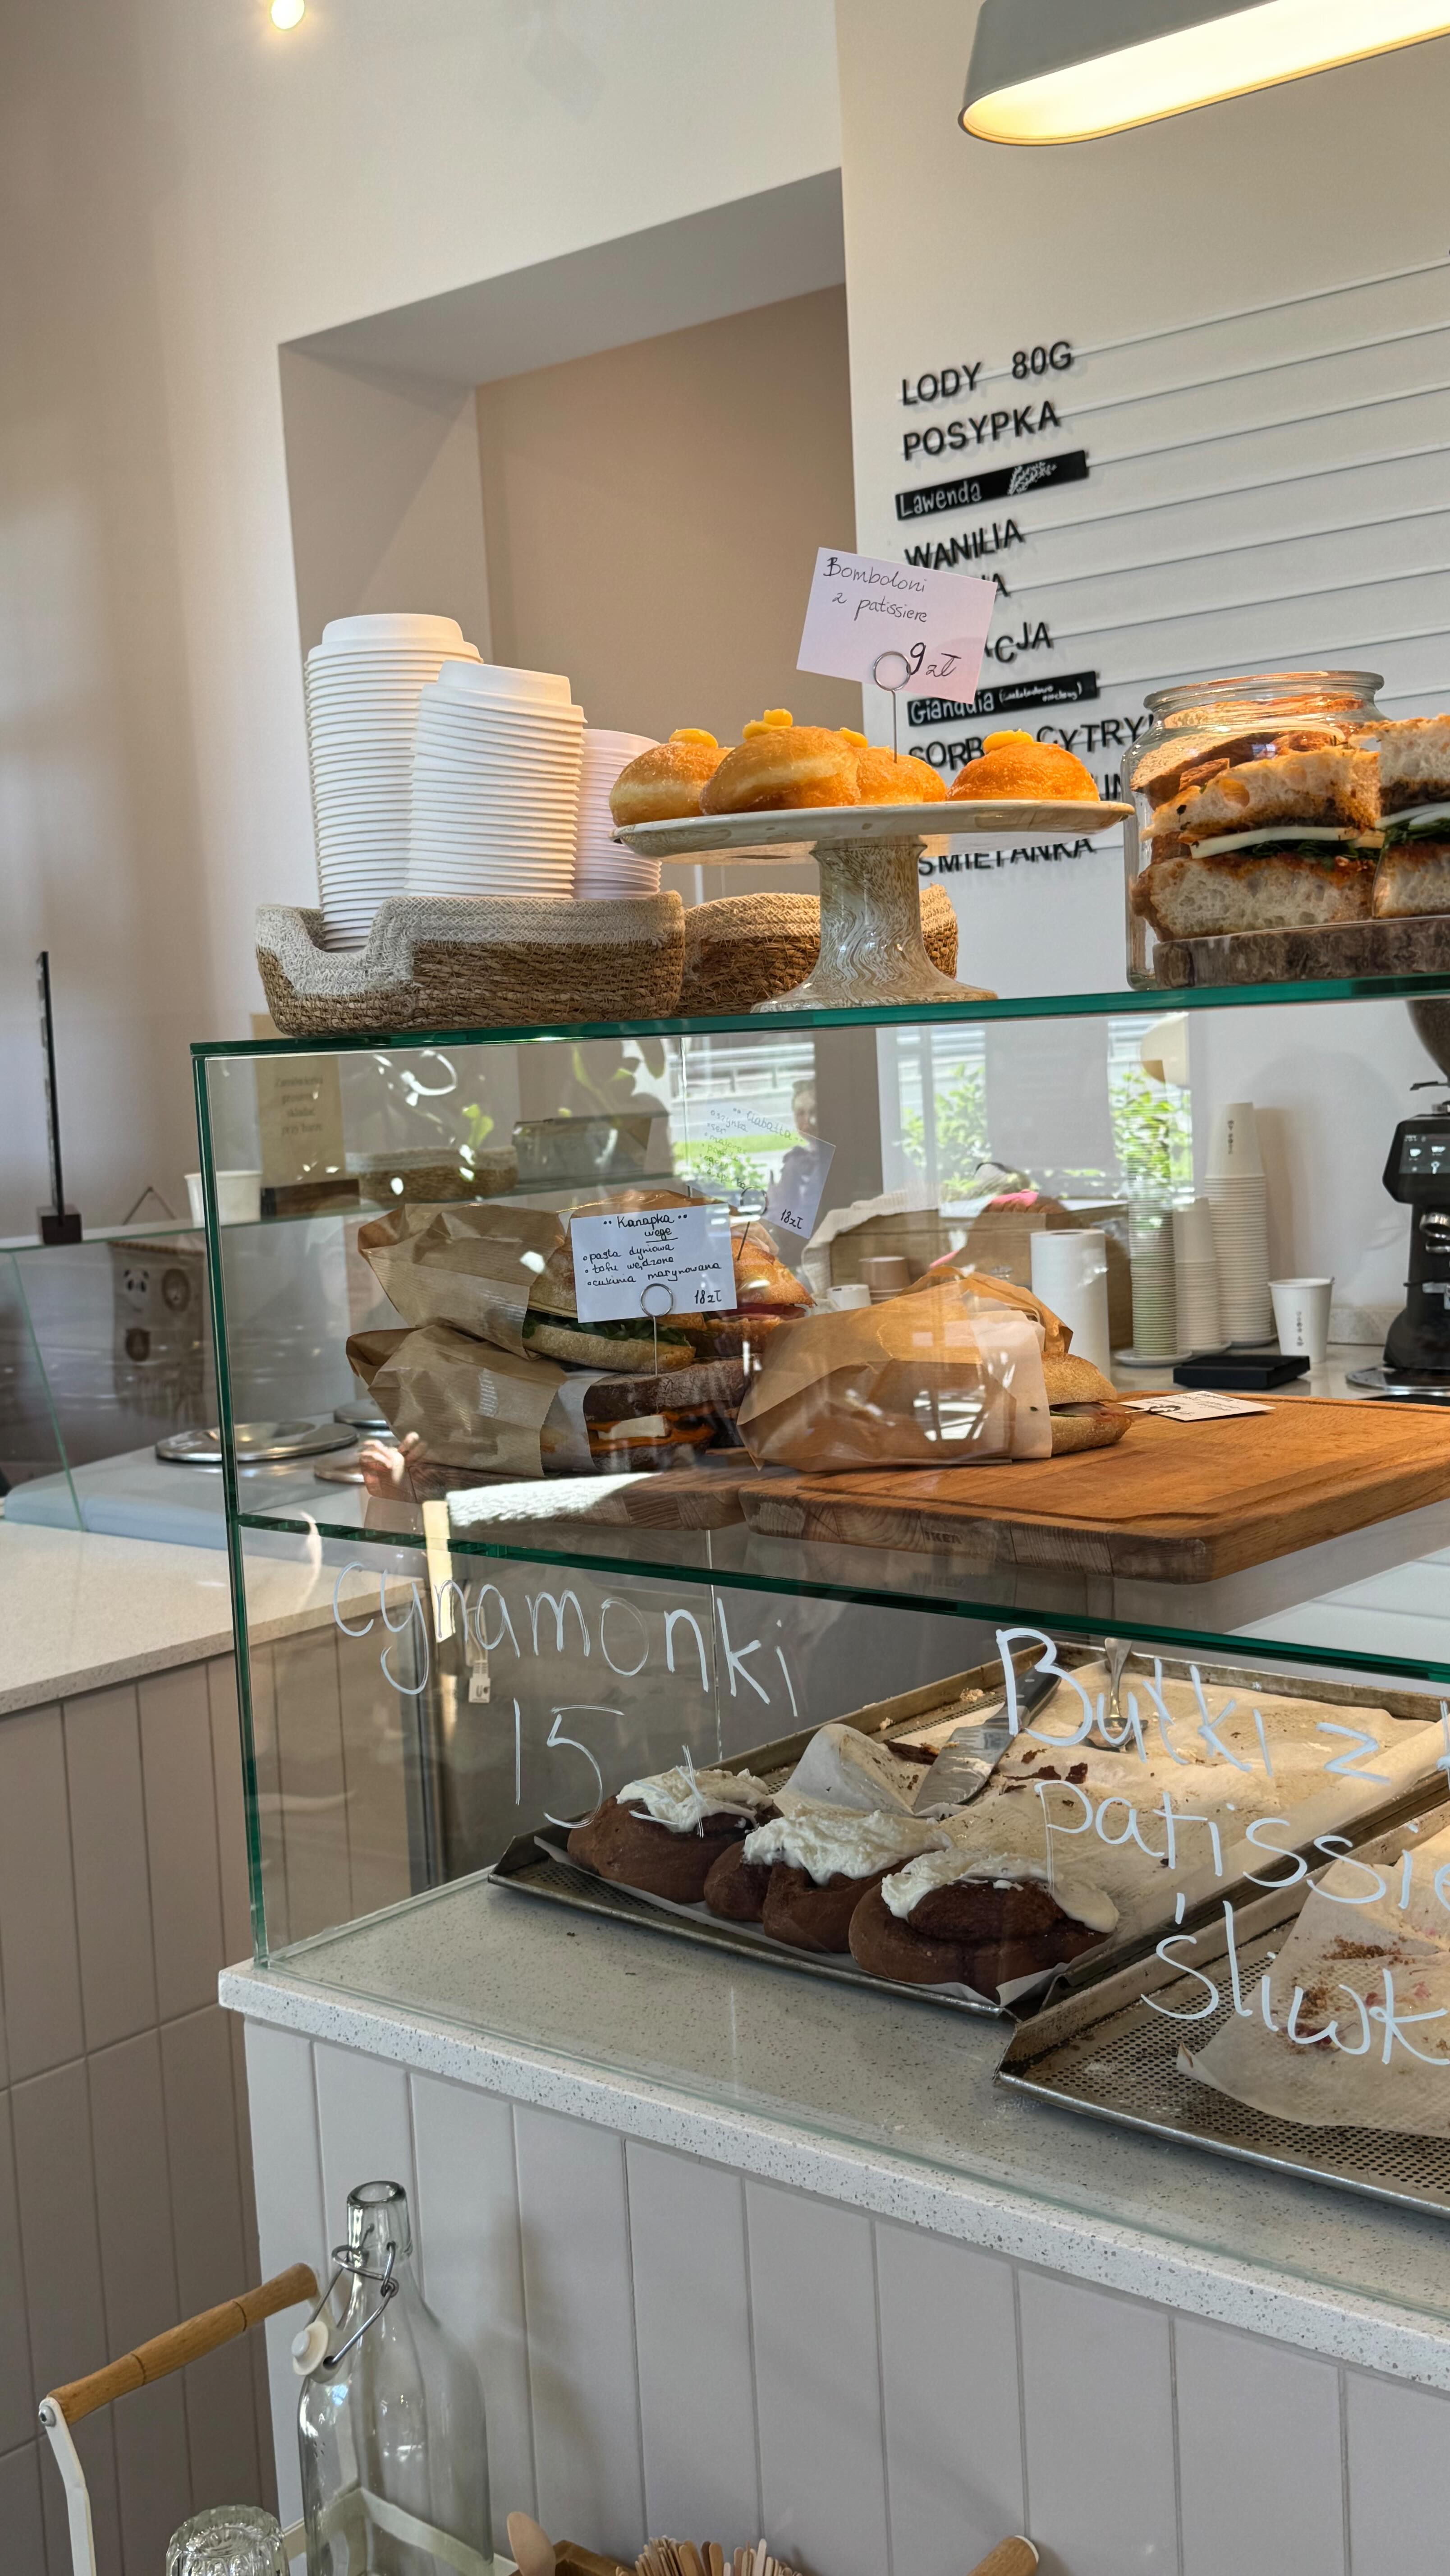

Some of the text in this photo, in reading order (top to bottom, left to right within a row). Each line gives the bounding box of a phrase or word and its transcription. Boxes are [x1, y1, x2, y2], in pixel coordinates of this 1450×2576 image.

[902, 340, 1072, 406] LODY 80G
[904, 400, 1060, 461] POSYPKA
[900, 480, 982, 518] Lawenda
[904, 518, 1026, 570] WANILIA
[823, 557, 927, 592] Bomboloni
[853, 596, 927, 623] patissiere
[909, 713, 1154, 770] SORB CYTRY
[616, 1213, 675, 1230] Kanapka
[644, 1227, 672, 1241] wege
[589, 1243, 675, 1263] pasta dyniowa
[592, 1262, 619, 1274] tofu
[593, 1262, 722, 1286] cukinia marynowana
[995, 1627, 1274, 1778] Bułki
[1315, 1721, 1391, 1784] z
[512, 1697, 625, 1829] 15
